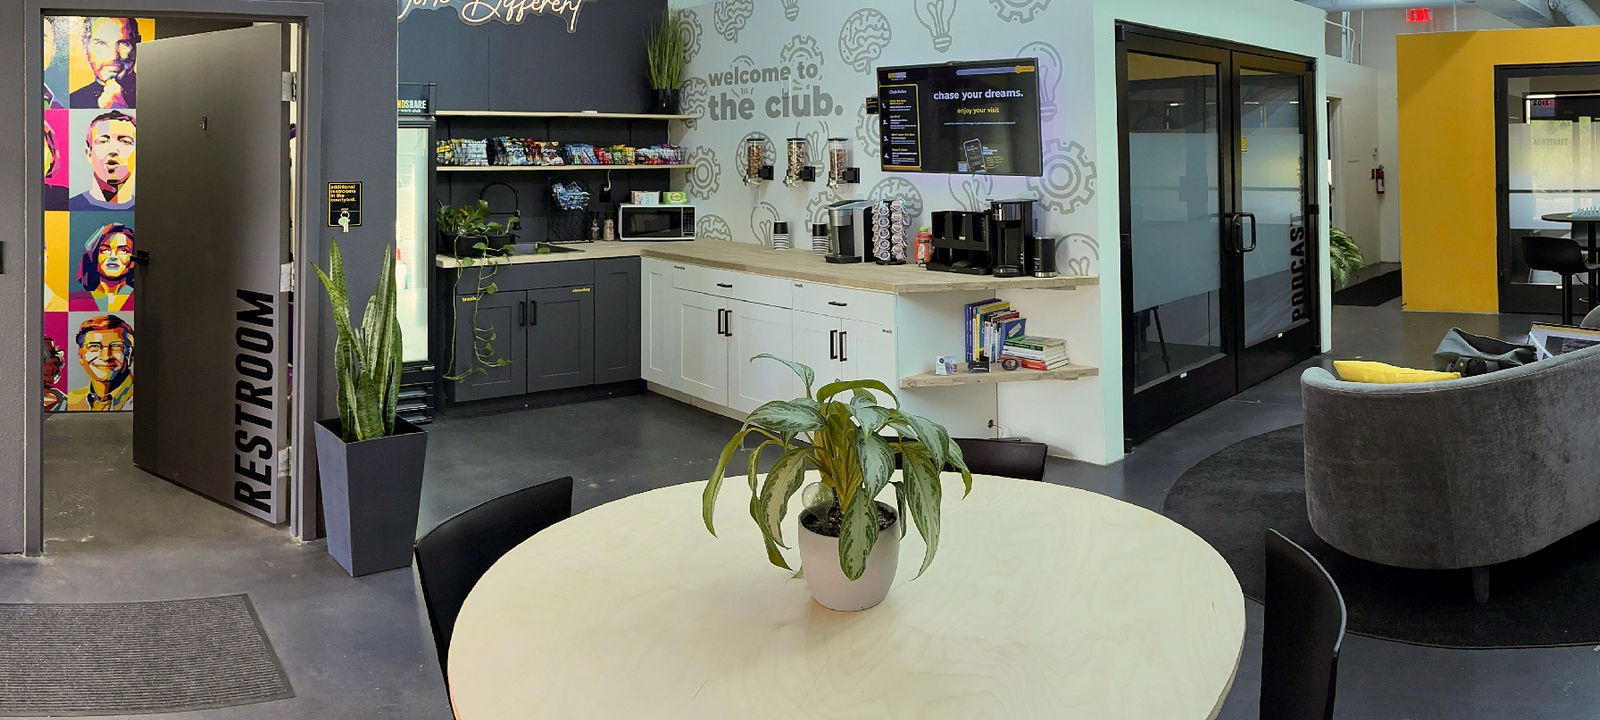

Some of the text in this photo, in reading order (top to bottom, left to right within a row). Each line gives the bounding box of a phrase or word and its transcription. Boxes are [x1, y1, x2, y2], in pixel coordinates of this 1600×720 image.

[708, 61, 819, 87] welcome to
[708, 92, 755, 121] the
[765, 85, 844, 119] club.
[933, 89, 1024, 101] chase your dreams.
[957, 107, 972, 115] enjoy
[973, 107, 986, 115] your
[1290, 213, 1305, 323] PODCAST
[234, 288, 274, 514] RESTROOM
